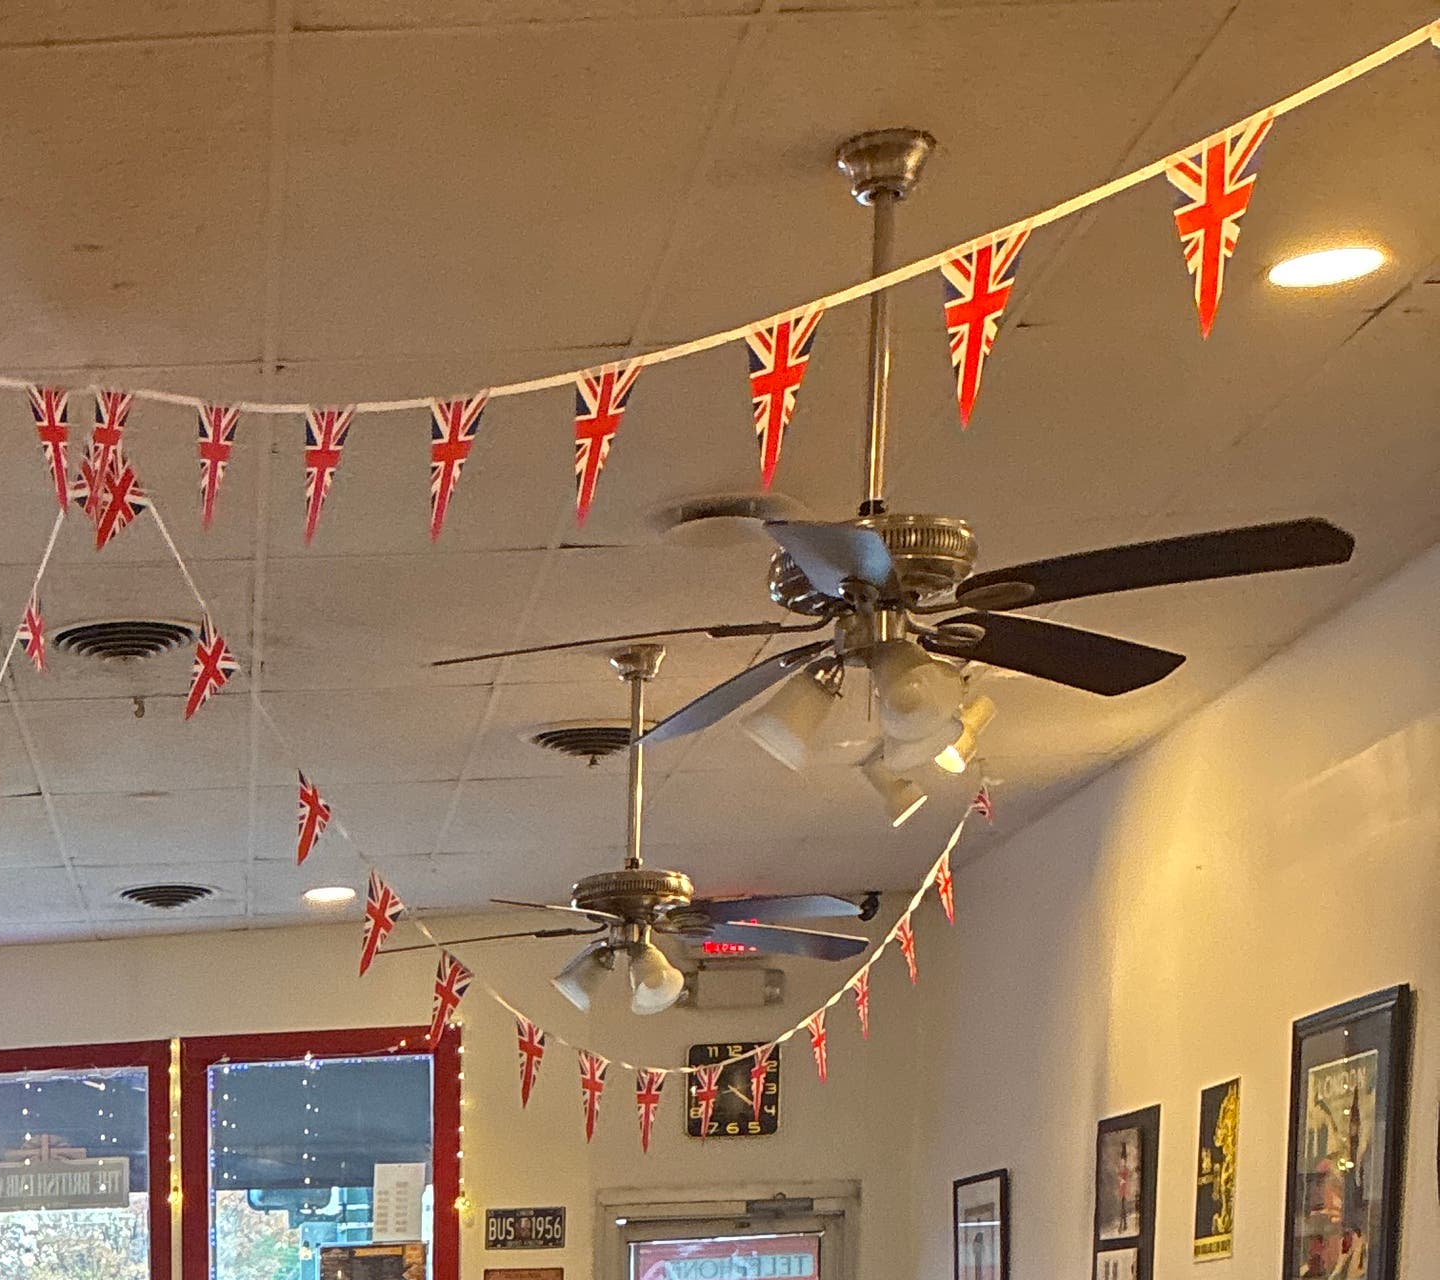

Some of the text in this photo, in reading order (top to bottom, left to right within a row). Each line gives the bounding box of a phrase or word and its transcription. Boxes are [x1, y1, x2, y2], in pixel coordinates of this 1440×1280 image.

[707, 1046, 719, 1058] 11
[727, 1045, 743, 1057] 12
[765, 1083, 777, 1095] 3
[763, 1105, 776, 1117] 4
[726, 1122, 740, 1134] 6
[747, 1121, 761, 1134] 5
[488, 1215, 561, 1241] BUS 1956
